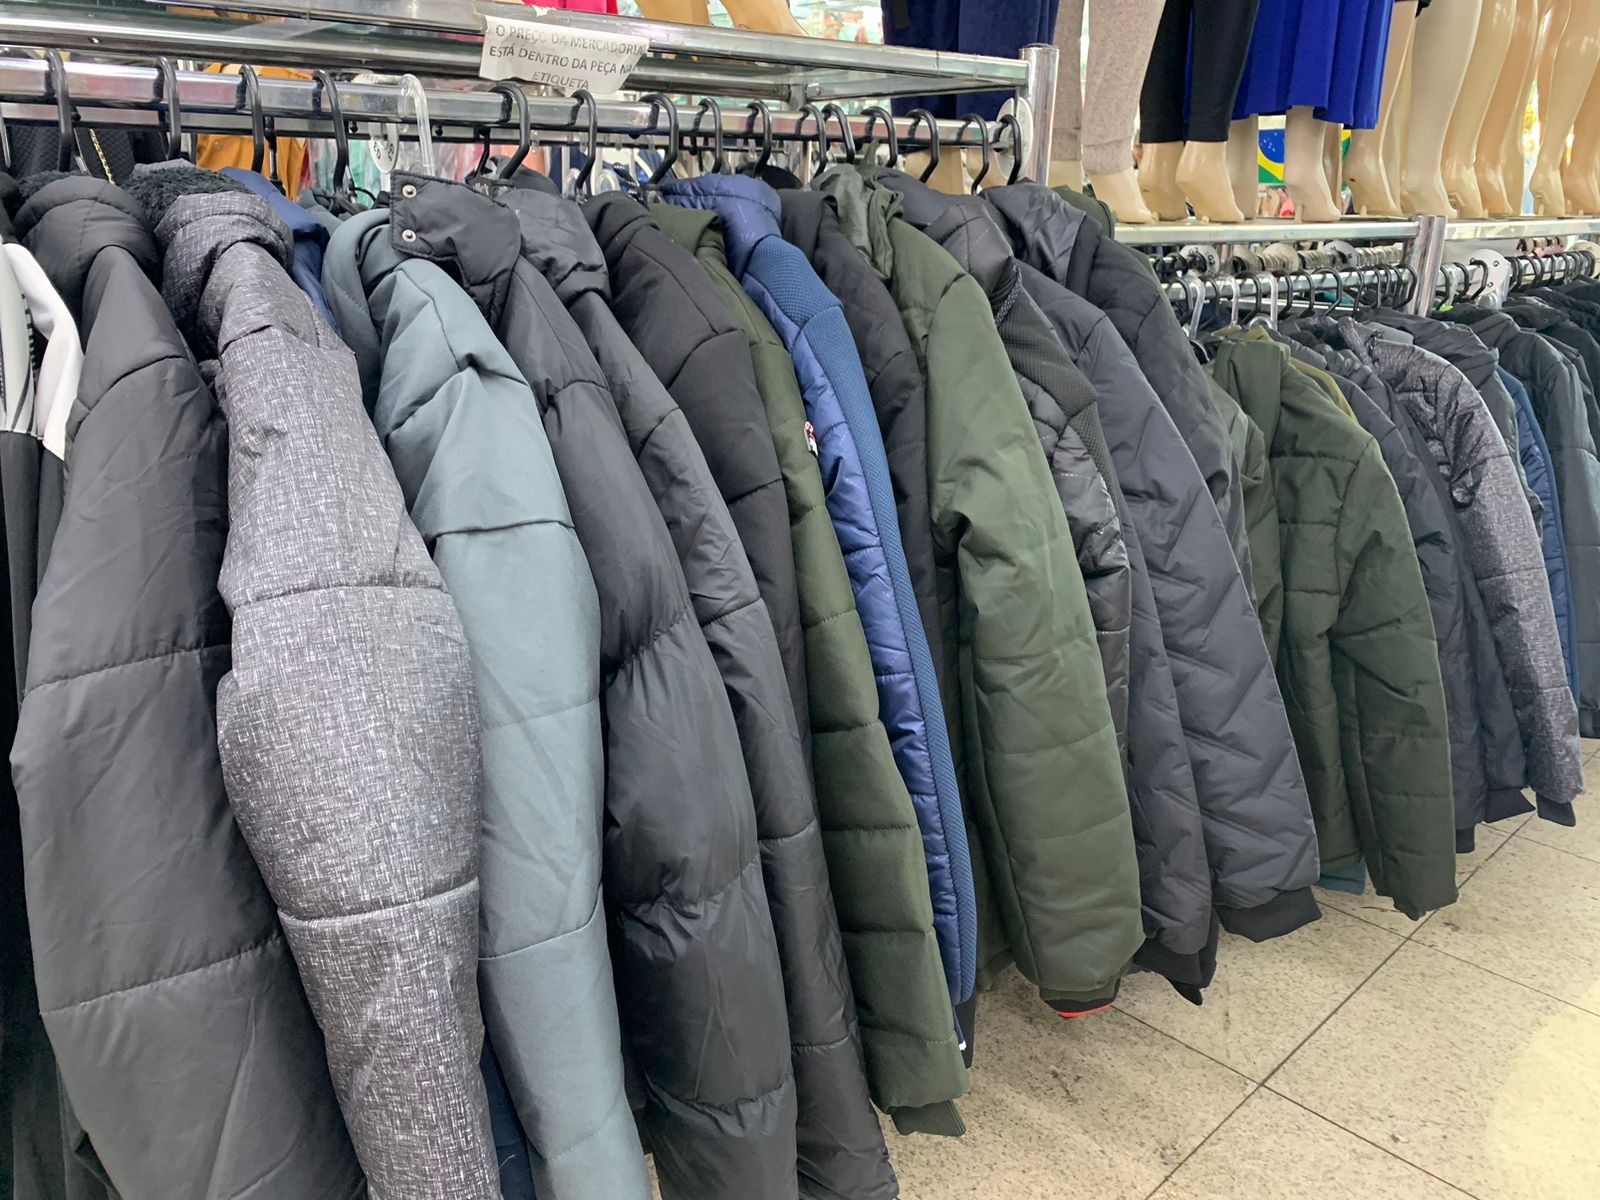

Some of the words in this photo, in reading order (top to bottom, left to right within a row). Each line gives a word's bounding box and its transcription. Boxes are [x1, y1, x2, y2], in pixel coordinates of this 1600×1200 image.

[496, 25, 506, 37] O
[551, 34, 568, 47] DA
[570, 36, 644, 56] MERCADORIA
[489, 43, 515, 58] ESTÁ
[518, 48, 569, 67] DENTRO
[571, 58, 588, 71] DA
[590, 60, 617, 76] PEÇA
[532, 71, 589, 90] ETIQUETA
